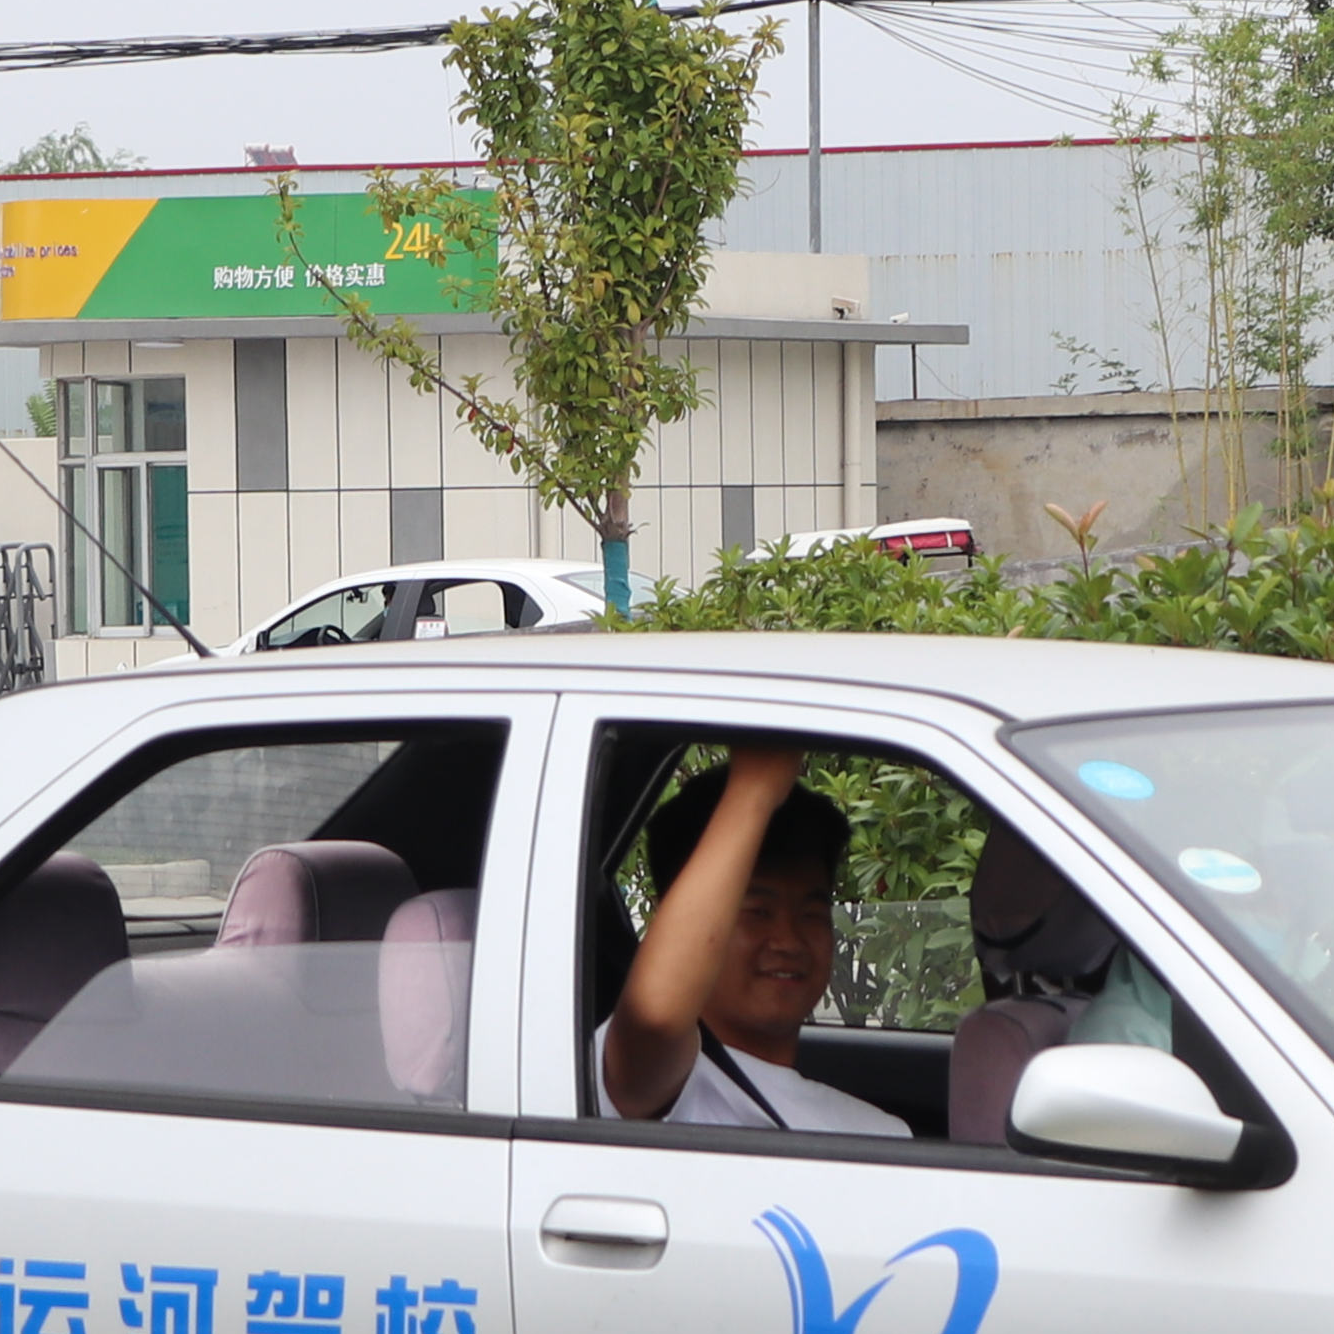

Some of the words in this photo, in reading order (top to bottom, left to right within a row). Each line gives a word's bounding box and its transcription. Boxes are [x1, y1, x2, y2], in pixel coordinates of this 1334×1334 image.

[213, 264, 295, 289] 购物方便
[304, 262, 386, 288] 价格实惠
